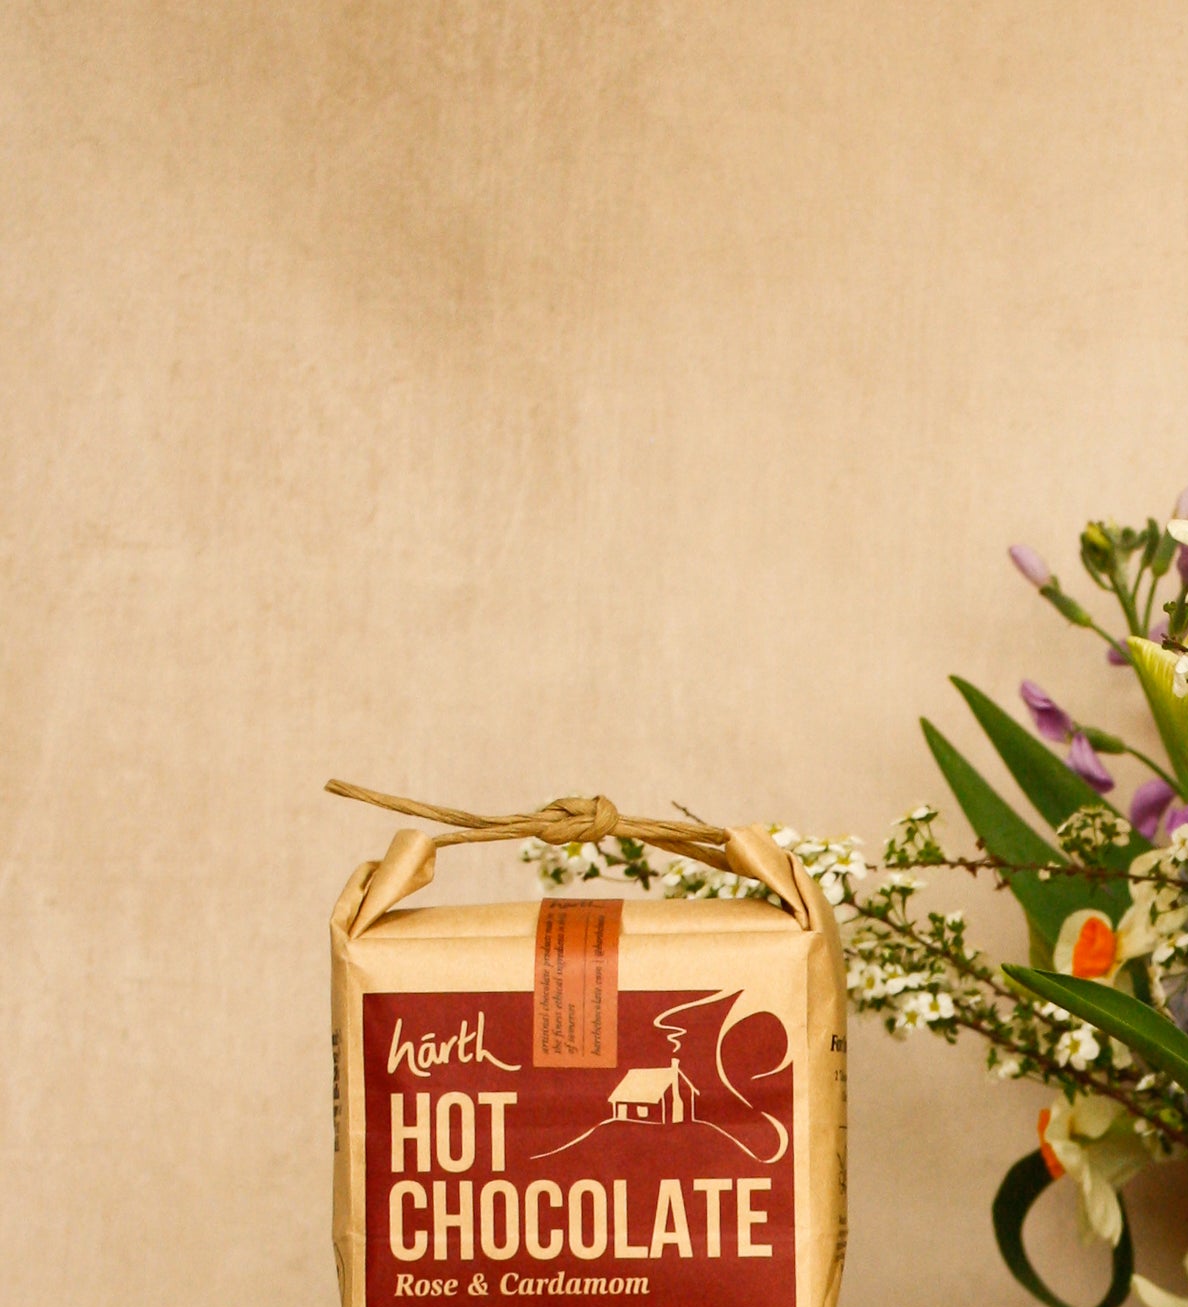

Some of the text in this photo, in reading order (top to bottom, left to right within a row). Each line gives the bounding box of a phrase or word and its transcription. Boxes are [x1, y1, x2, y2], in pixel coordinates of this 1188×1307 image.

[390, 1092, 518, 1173] HOT
[388, 1177, 773, 1262] CHOCOLATE
[394, 1270, 651, 1297] Rose & Cardamom
